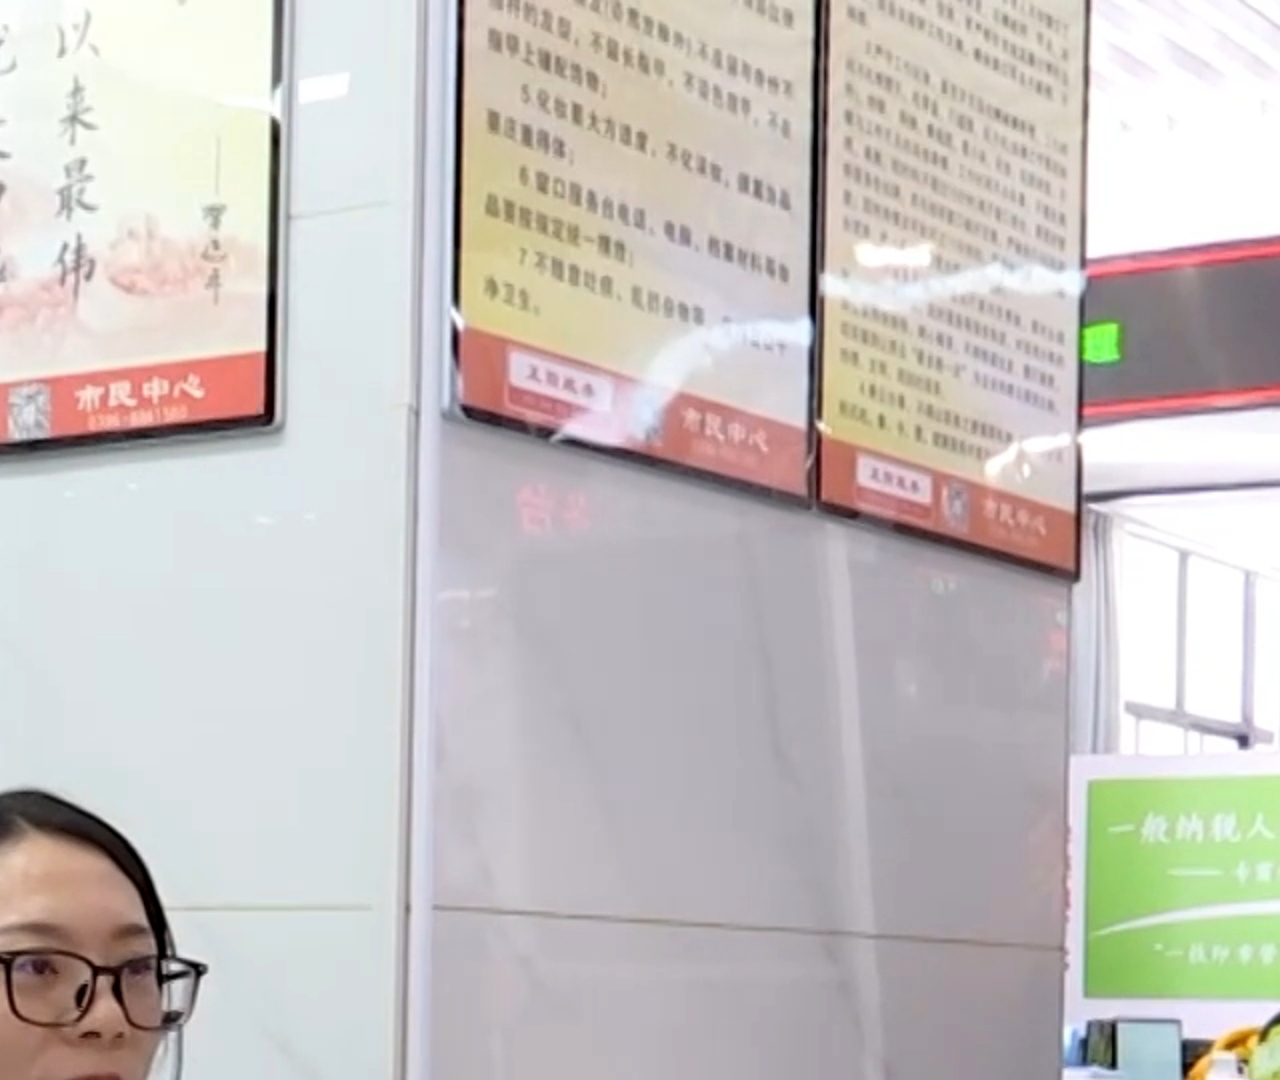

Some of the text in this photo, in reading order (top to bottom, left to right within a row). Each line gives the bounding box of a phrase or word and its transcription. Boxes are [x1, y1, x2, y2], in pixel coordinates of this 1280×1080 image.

[54, 8, 100, 303] 以来最伟
[75, 372, 205, 411] 市民中心
[682, 406, 768, 453] 市民中心
